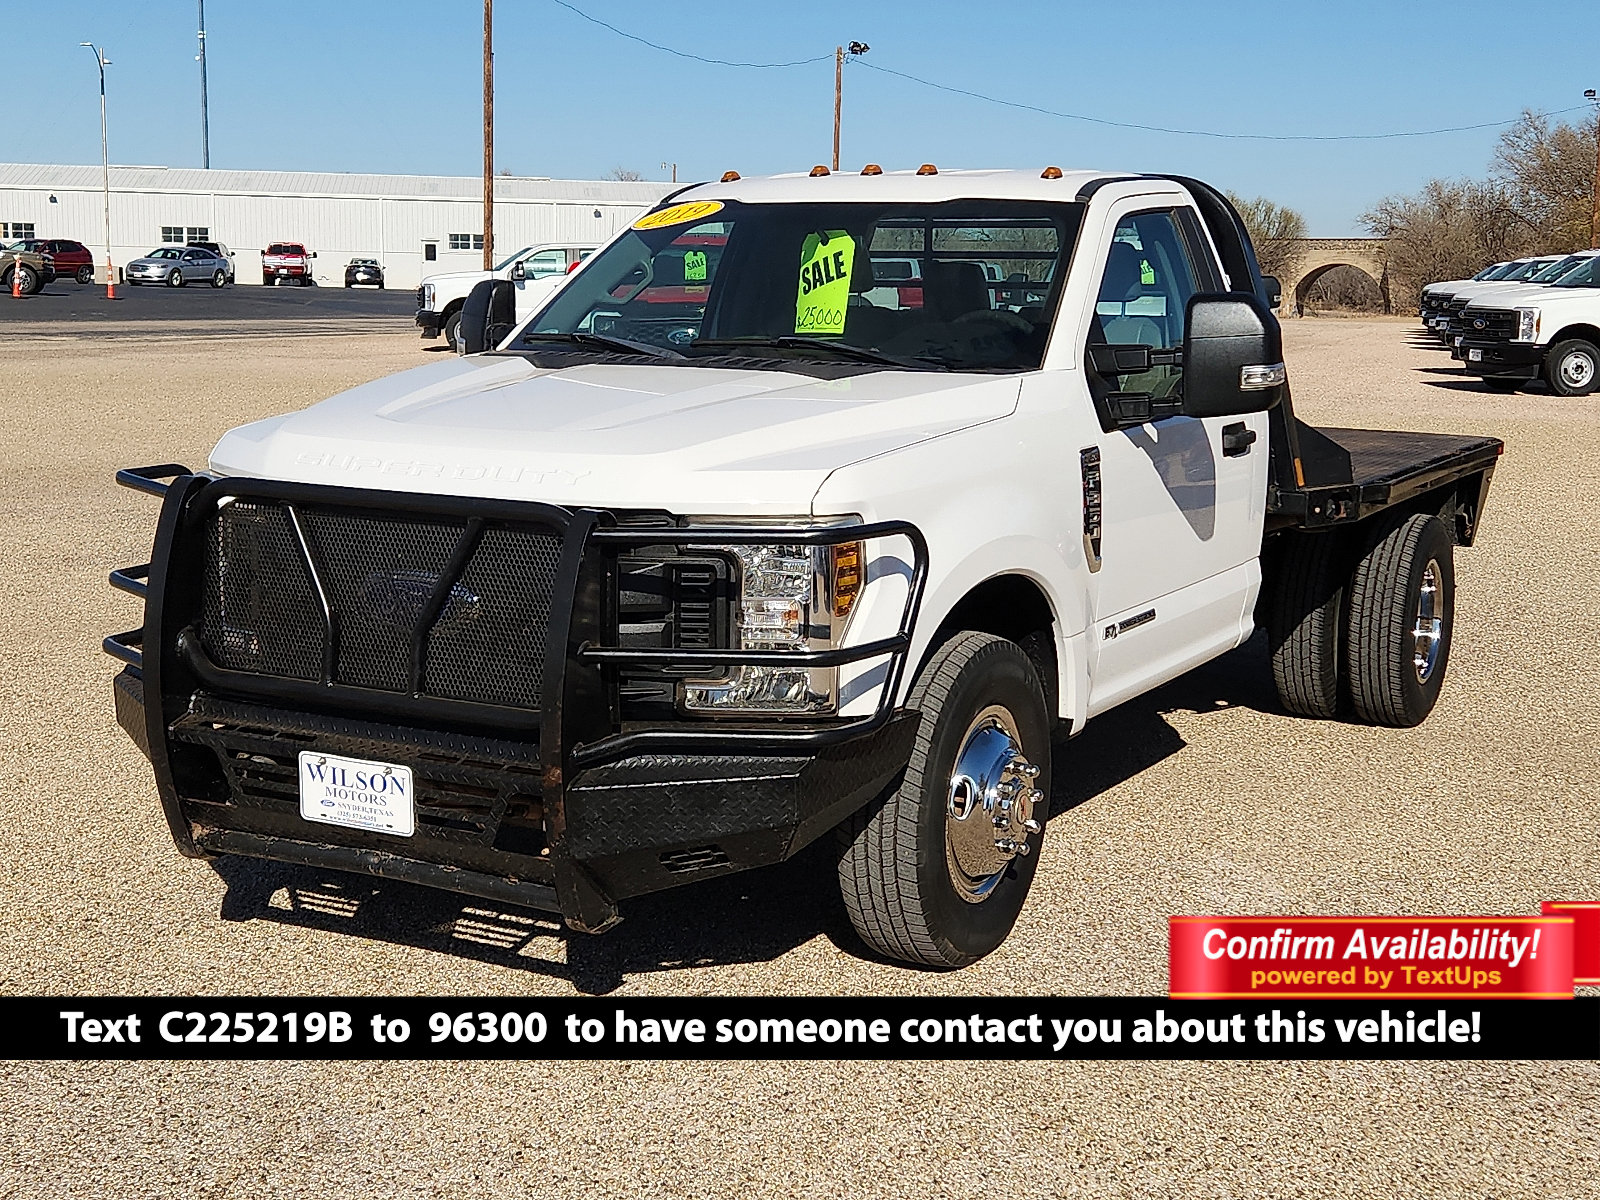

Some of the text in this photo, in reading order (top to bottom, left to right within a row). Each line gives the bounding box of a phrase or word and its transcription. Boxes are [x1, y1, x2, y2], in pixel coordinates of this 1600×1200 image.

[641, 203, 712, 228] 2019
[686, 257, 705, 271] SALE
[801, 250, 847, 296] SALE
[294, 452, 593, 486] SUPER DUTY
[306, 762, 406, 797] WILSON
[325, 786, 387, 807] MOTORS
